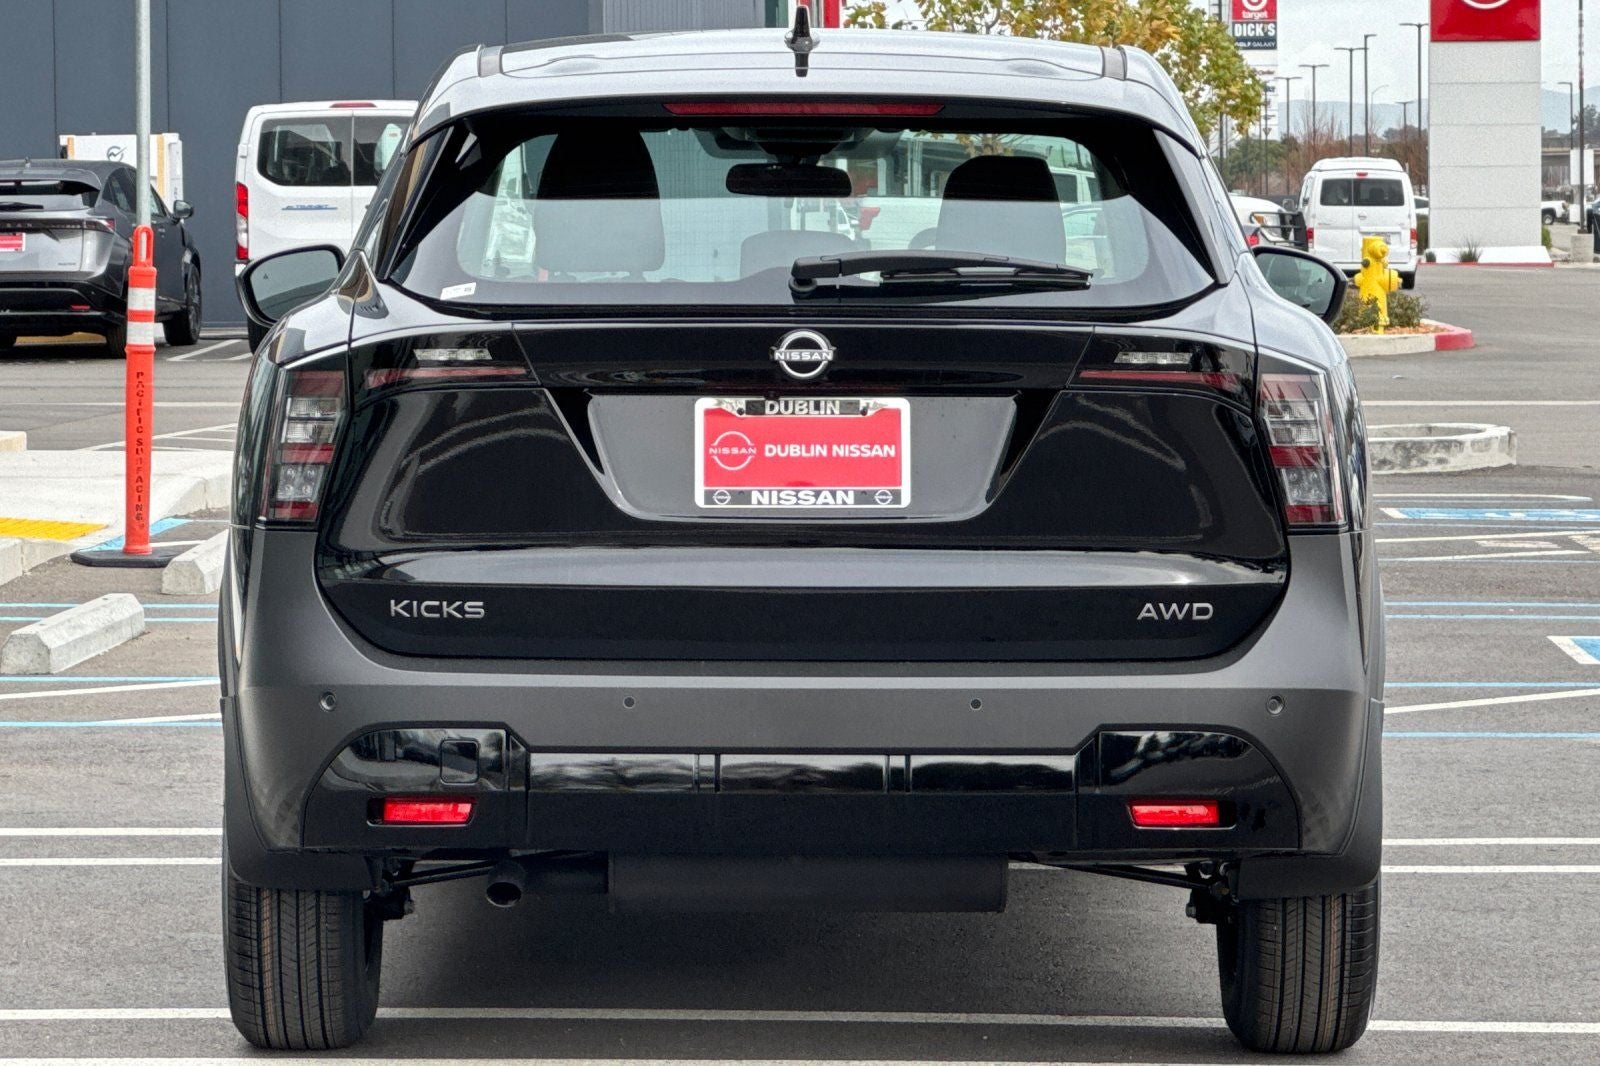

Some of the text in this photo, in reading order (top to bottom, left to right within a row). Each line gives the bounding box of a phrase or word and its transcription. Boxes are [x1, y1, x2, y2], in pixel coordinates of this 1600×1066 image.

[1242, 11, 1268, 20] target
[1234, 23, 1275, 37] DICK'S
[775, 351, 832, 361] NISSAN
[765, 400, 840, 415] DUBLIN
[709, 447, 757, 455] NISSAN
[764, 444, 896, 457] DUBLIN NISSAN
[751, 490, 855, 505] NISSAN
[390, 600, 485, 618] KICKS
[1136, 602, 1214, 620] AWD
